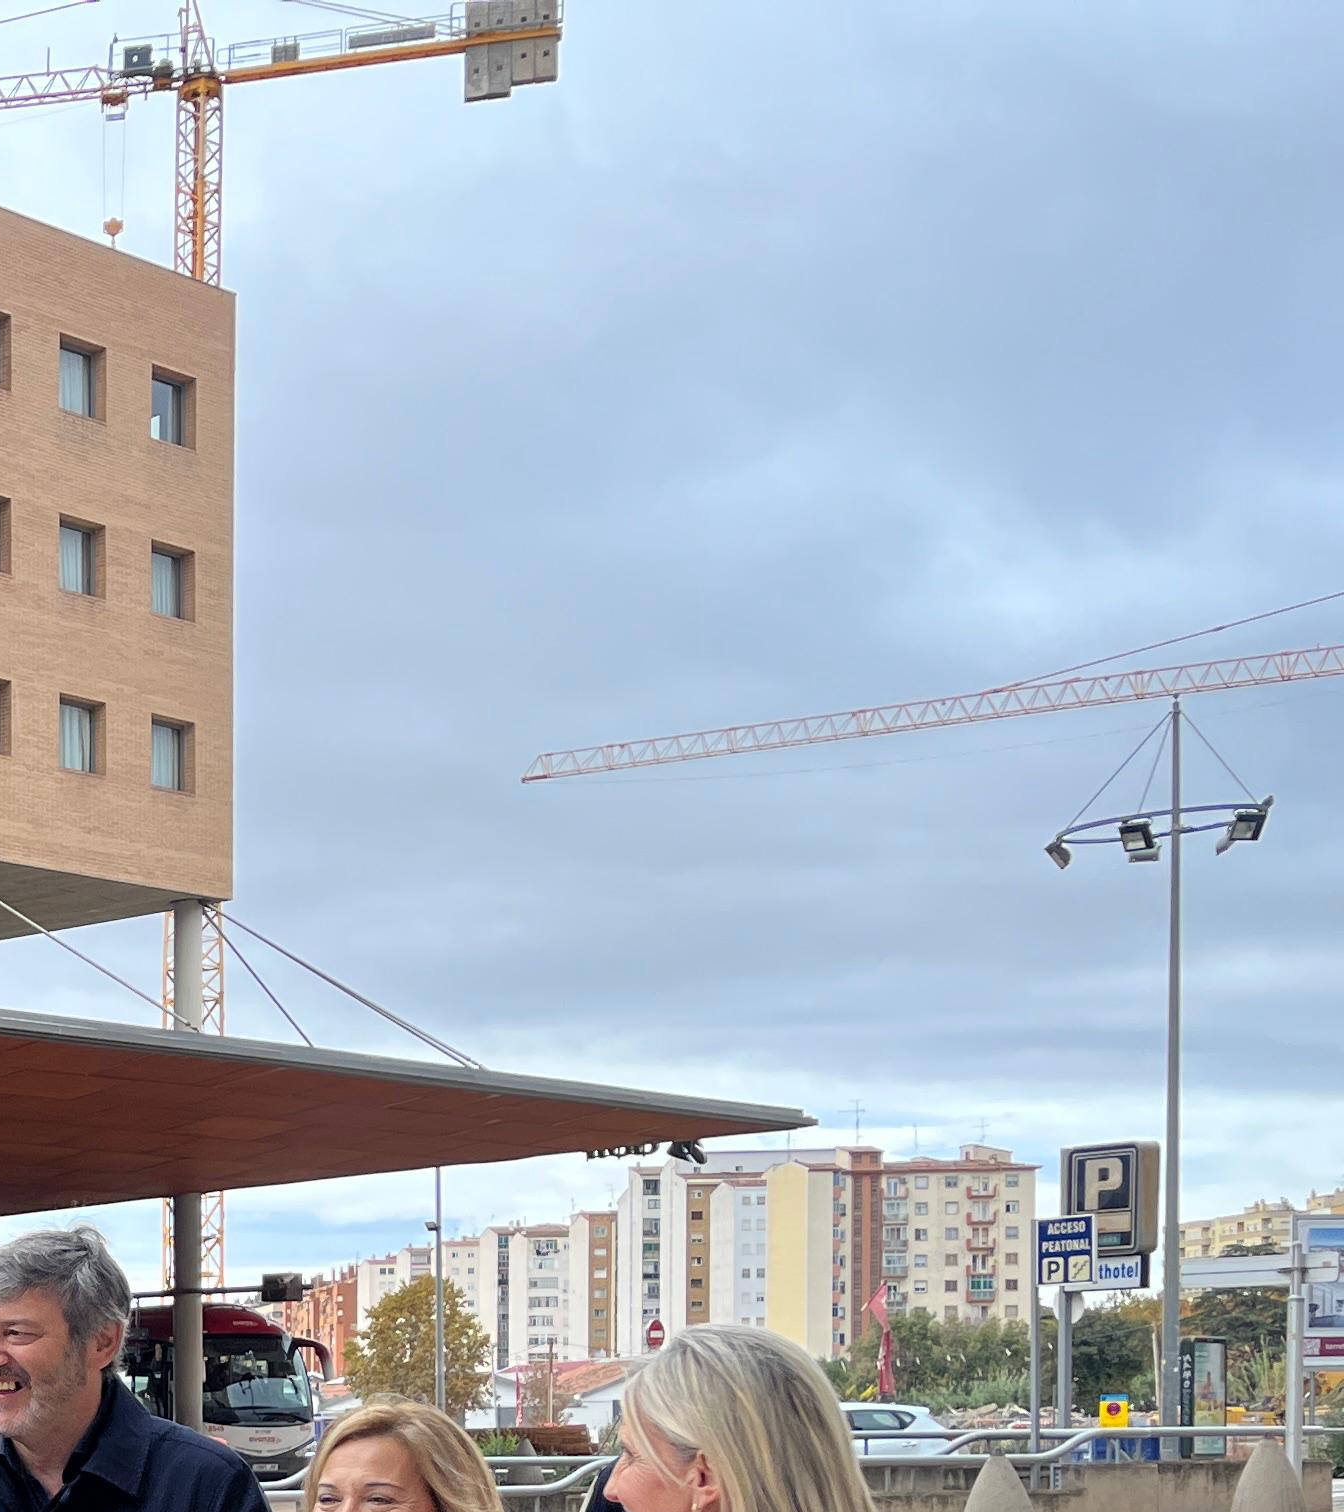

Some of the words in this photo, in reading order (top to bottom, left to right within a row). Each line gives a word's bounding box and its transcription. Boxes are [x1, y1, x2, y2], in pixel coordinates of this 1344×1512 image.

[1084, 1157, 1123, 1211] P
[1047, 1220, 1086, 1235] ACCESO
[1041, 1238, 1091, 1254] PEATONAL
[1047, 1260, 1061, 1281] P
[1098, 1261, 1140, 1280] thotel
